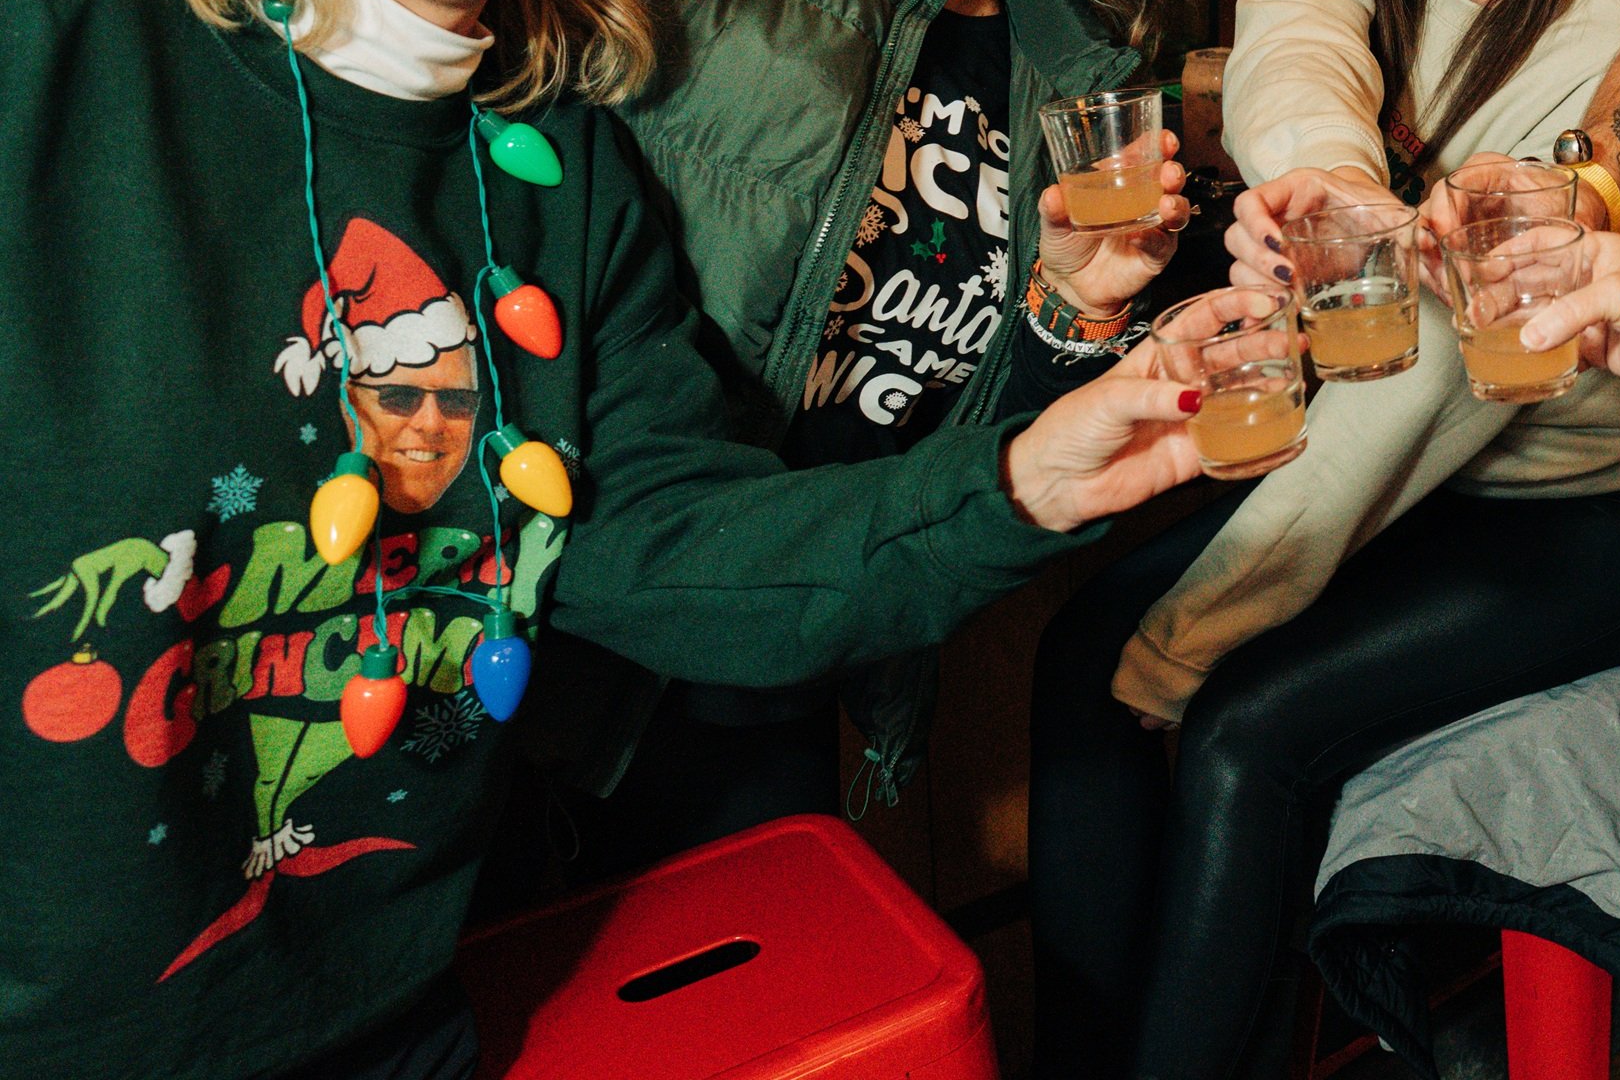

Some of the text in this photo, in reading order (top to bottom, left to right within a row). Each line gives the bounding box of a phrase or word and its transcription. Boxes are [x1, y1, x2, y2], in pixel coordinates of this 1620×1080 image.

[882, 125, 1009, 240] ICE
[847, 323, 977, 384] CAME
[218, 512, 567, 628] MERRY
